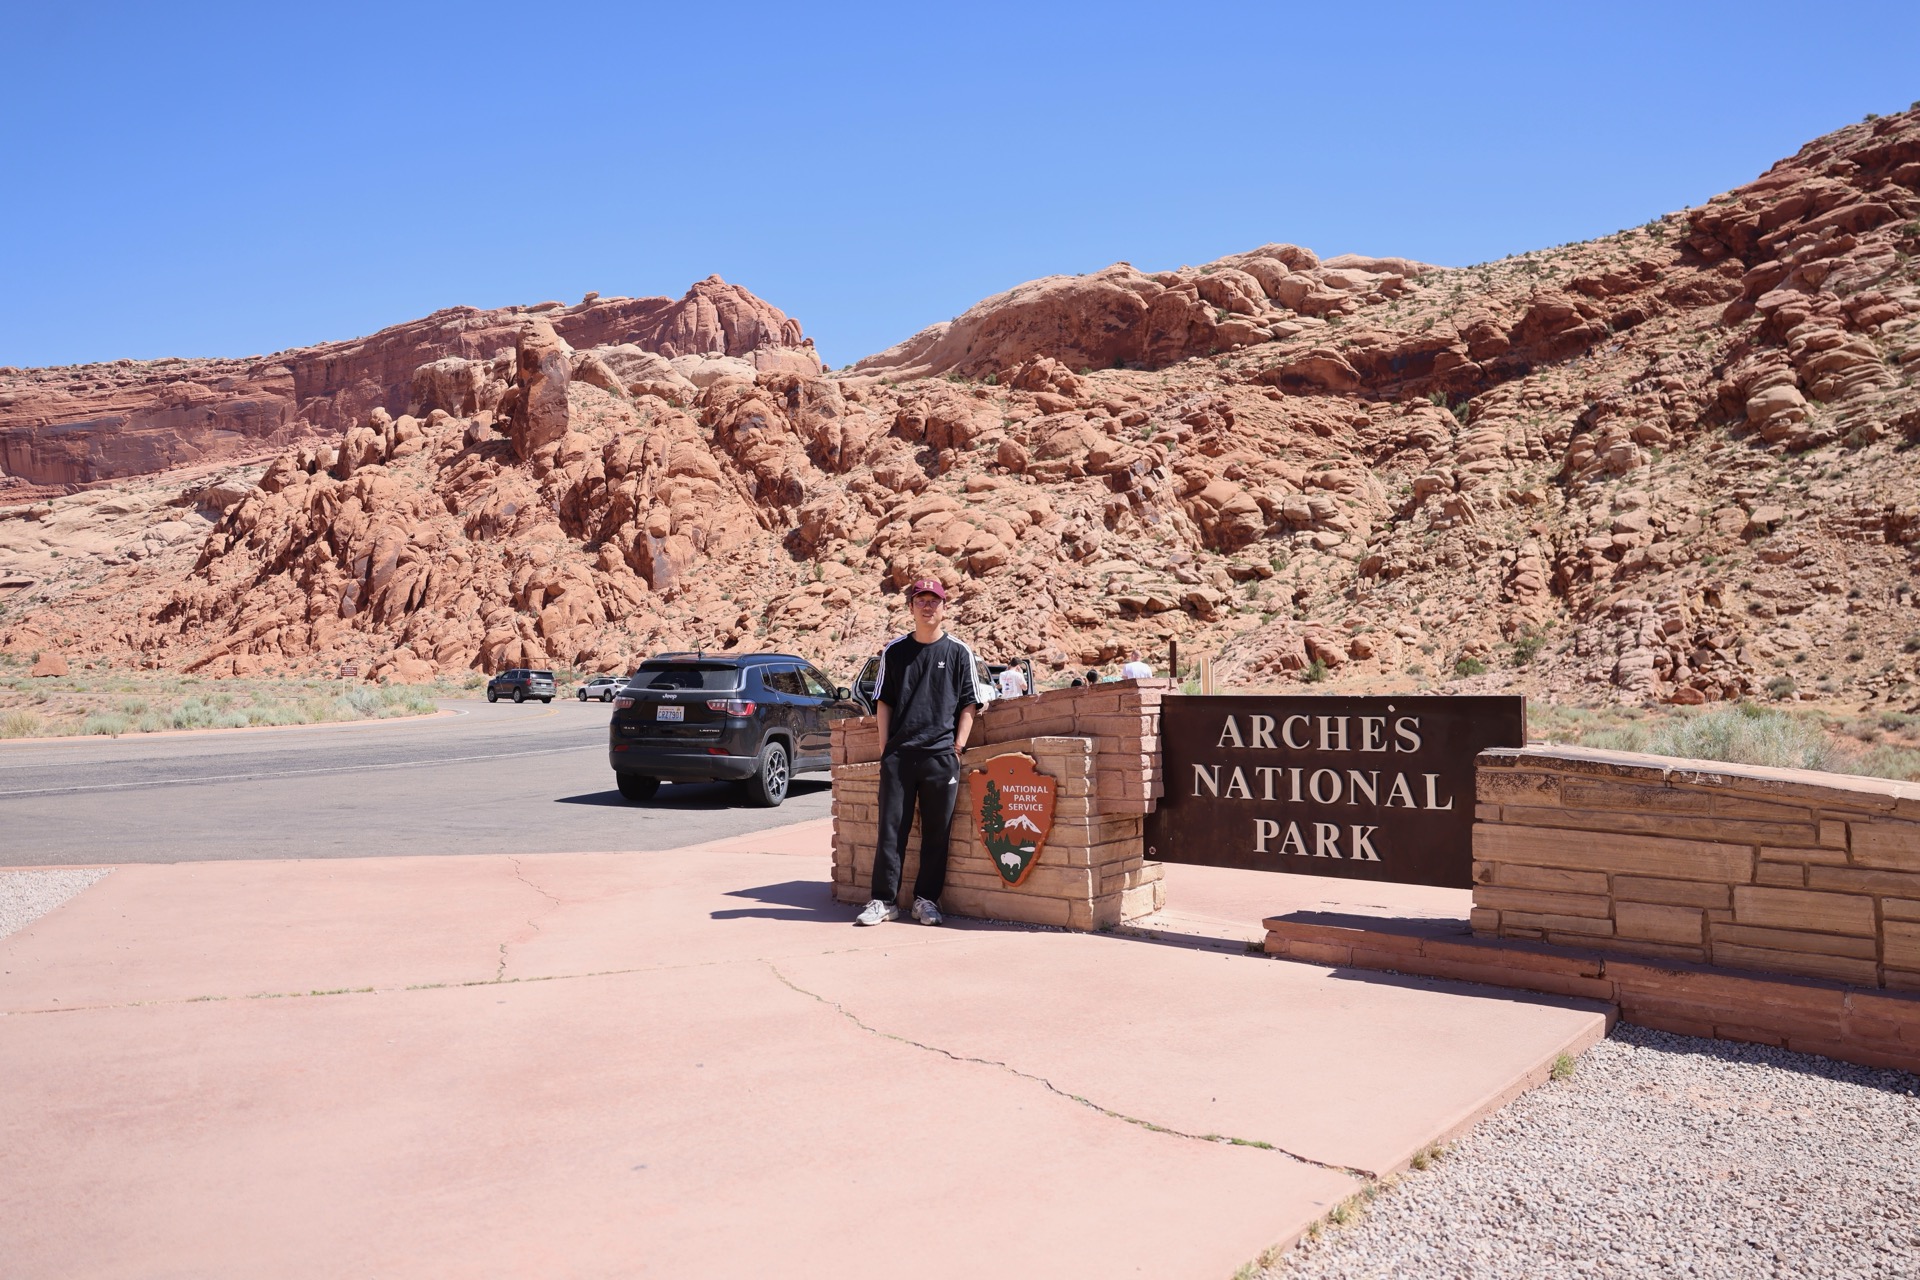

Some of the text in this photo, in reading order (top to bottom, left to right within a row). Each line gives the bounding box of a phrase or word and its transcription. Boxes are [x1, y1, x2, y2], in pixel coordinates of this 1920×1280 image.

[923, 581, 935, 590] H
[1216, 714, 1422, 753] ARCHES
[1002, 785, 1048, 793] NATIONAL
[1191, 763, 1453, 810] NATIONAL
[1013, 794, 1037, 802] PARK
[1008, 803, 1043, 811] SERVICE
[1252, 818, 1383, 862] PARK
